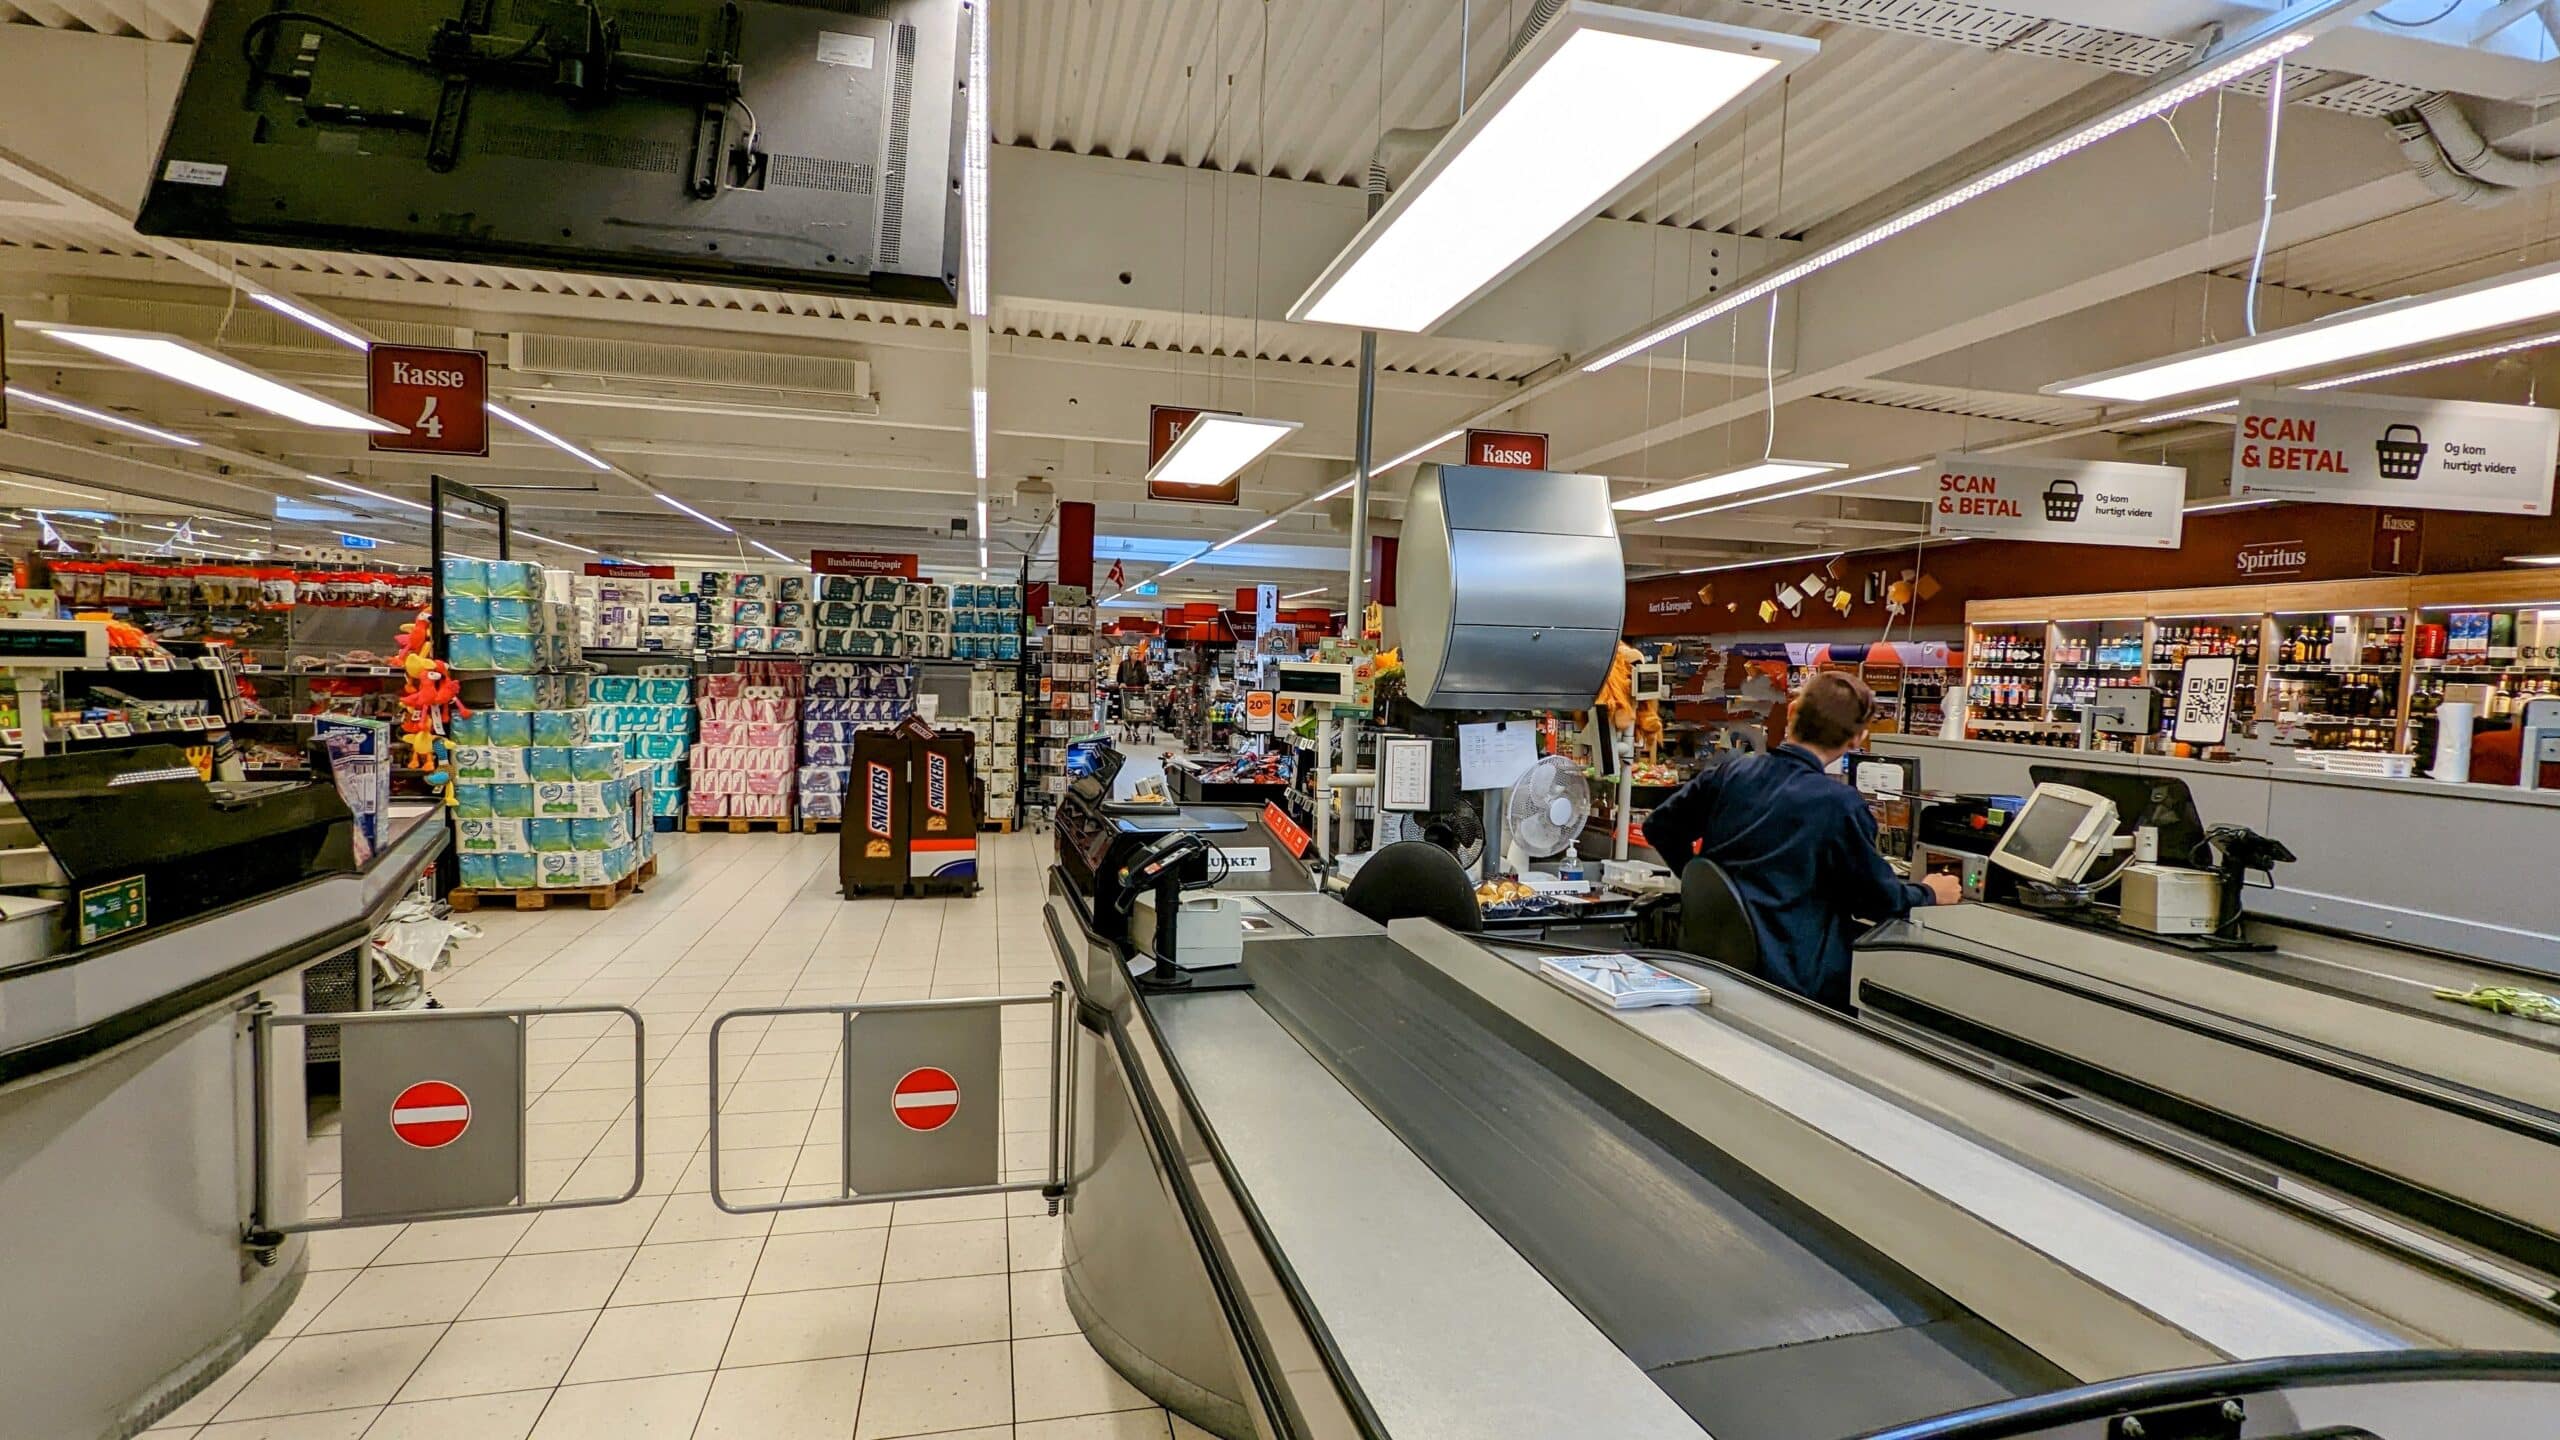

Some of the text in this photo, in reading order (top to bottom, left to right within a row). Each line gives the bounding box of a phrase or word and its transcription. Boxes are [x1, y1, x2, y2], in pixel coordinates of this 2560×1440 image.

[391, 361, 464, 388] Kasse
[415, 396, 443, 438] 4
[2243, 416, 2316, 442] SCAN
[1483, 444, 1532, 465] Kasse
[2241, 445, 2349, 474] & BETAL
[2444, 442, 2486, 456] Og kom
[2443, 458, 2517, 474] hurtigt videre
[1940, 474, 1996, 494] SCAN
[1938, 496, 2022, 517] & BETAL
[2096, 493, 2129, 504] Og kom
[2095, 506, 2152, 518] hurtigt videre
[2382, 514, 2416, 531] Kasse
[2237, 548, 2306, 572] Spiritus
[2392, 536, 2400, 564] 1
[827, 557, 902, 570] Husholdningspapir
[930, 755, 945, 811] SNICKERS
[871, 766, 889, 833] SNICKERS
